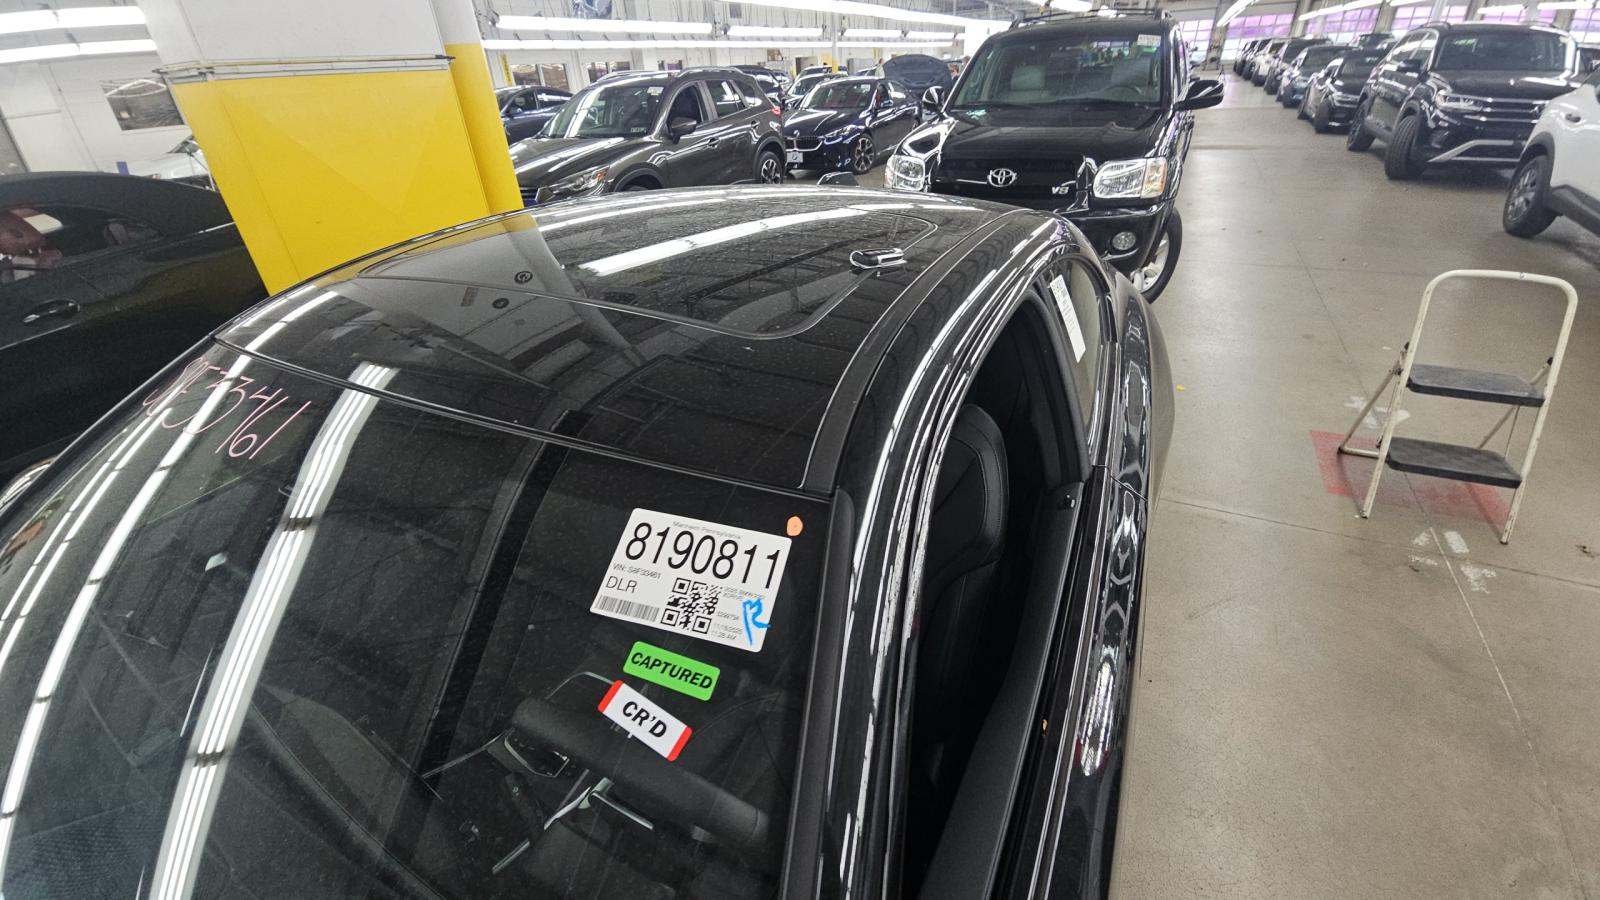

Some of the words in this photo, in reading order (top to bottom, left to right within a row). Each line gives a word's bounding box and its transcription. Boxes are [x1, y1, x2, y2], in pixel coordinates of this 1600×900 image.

[625, 522, 781, 589] 8190811
[605, 575, 638, 594] DLR
[631, 652, 713, 689] CAPTURED
[622, 701, 667, 738] CR'D
